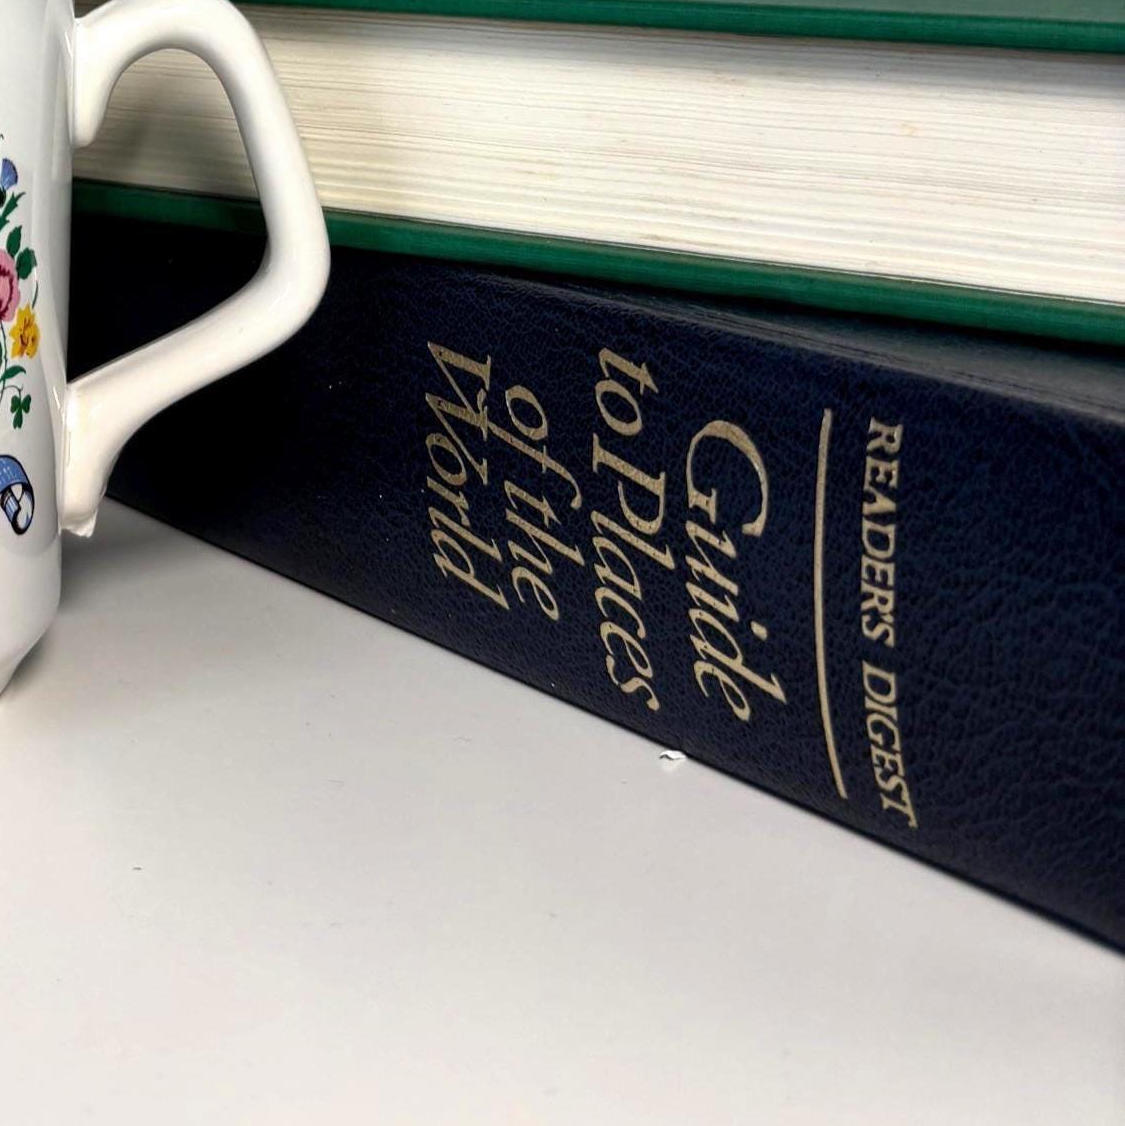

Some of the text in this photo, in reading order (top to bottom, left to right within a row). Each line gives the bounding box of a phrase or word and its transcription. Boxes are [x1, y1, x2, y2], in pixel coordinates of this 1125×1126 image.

[425, 340, 511, 611] World
[476, 384, 586, 622] of the
[591, 347, 676, 712] to Places
[686, 419, 788, 723] Guide
[861, 659, 918, 829] DIGEST
